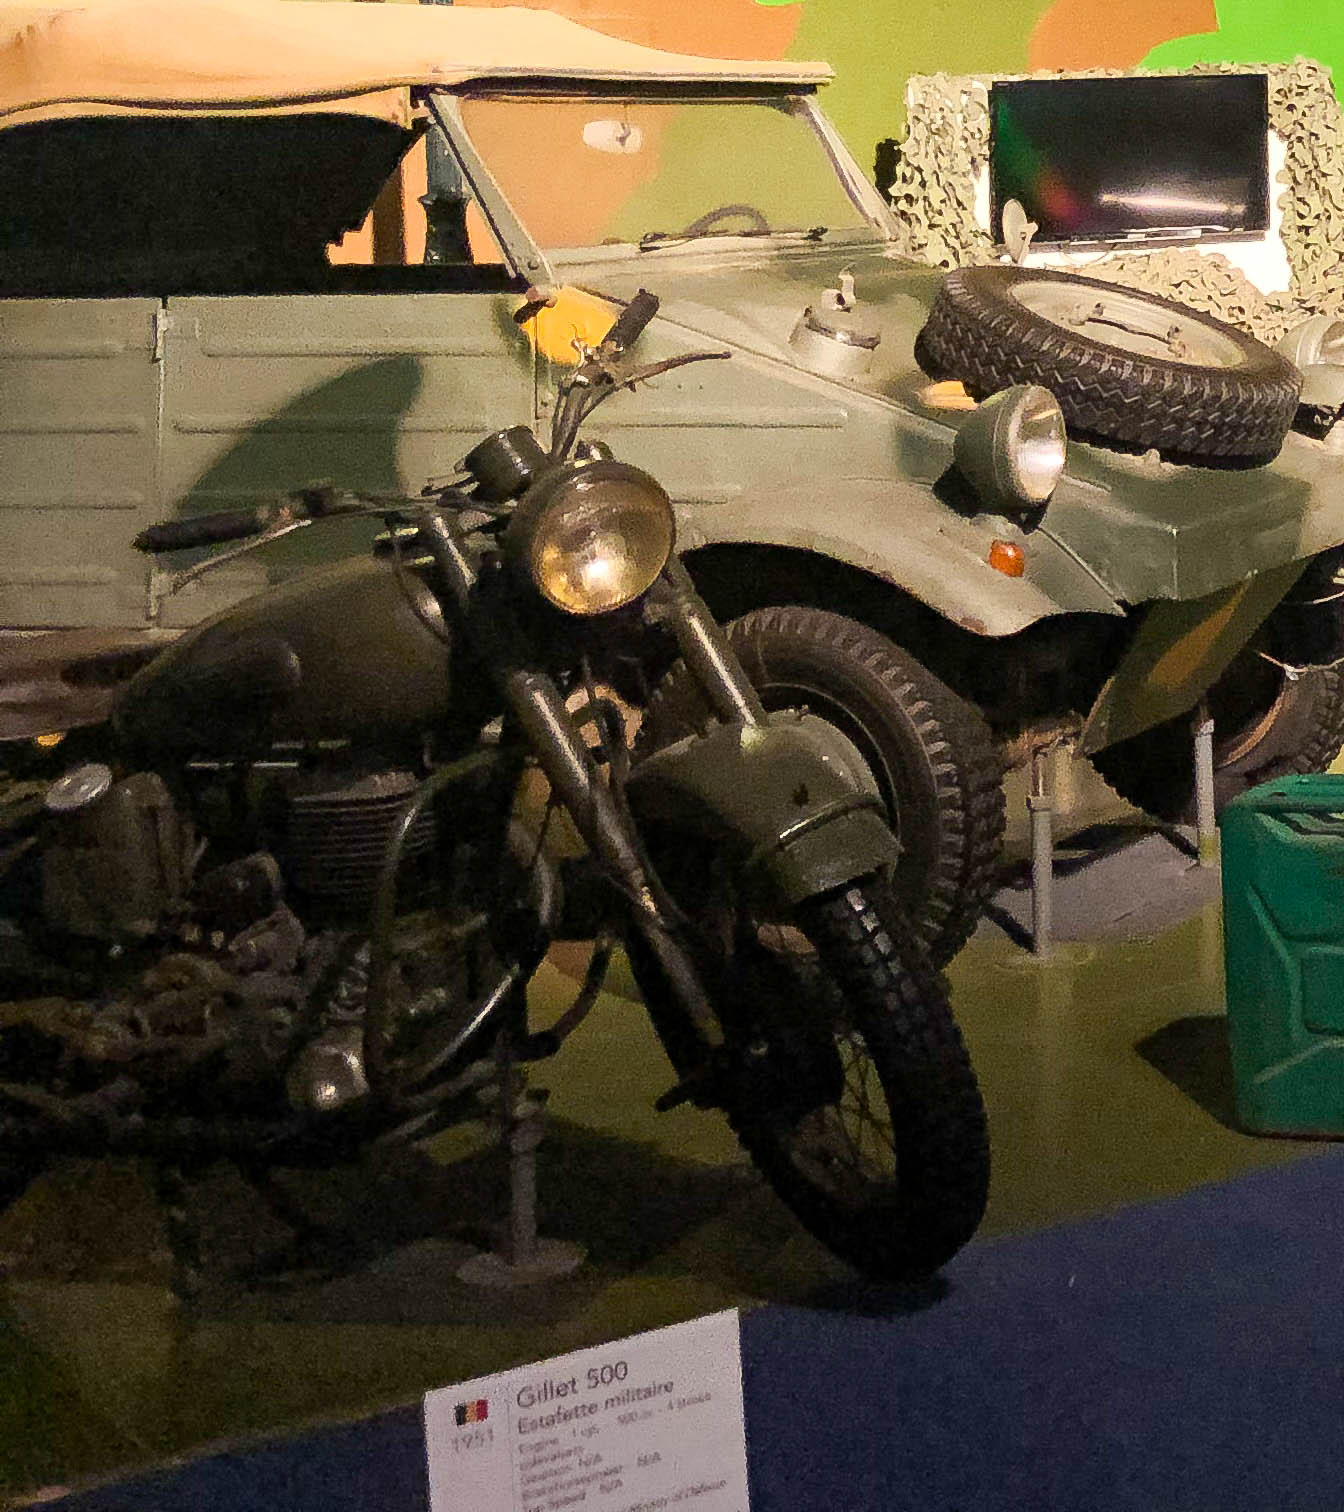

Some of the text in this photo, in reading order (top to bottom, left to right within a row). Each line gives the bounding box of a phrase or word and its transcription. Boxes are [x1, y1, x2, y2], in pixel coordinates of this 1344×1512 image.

[516, 1360, 629, 1409] Gillet 500
[518, 1400, 600, 1435] Estafette
[604, 1379, 675, 1410] militaire
